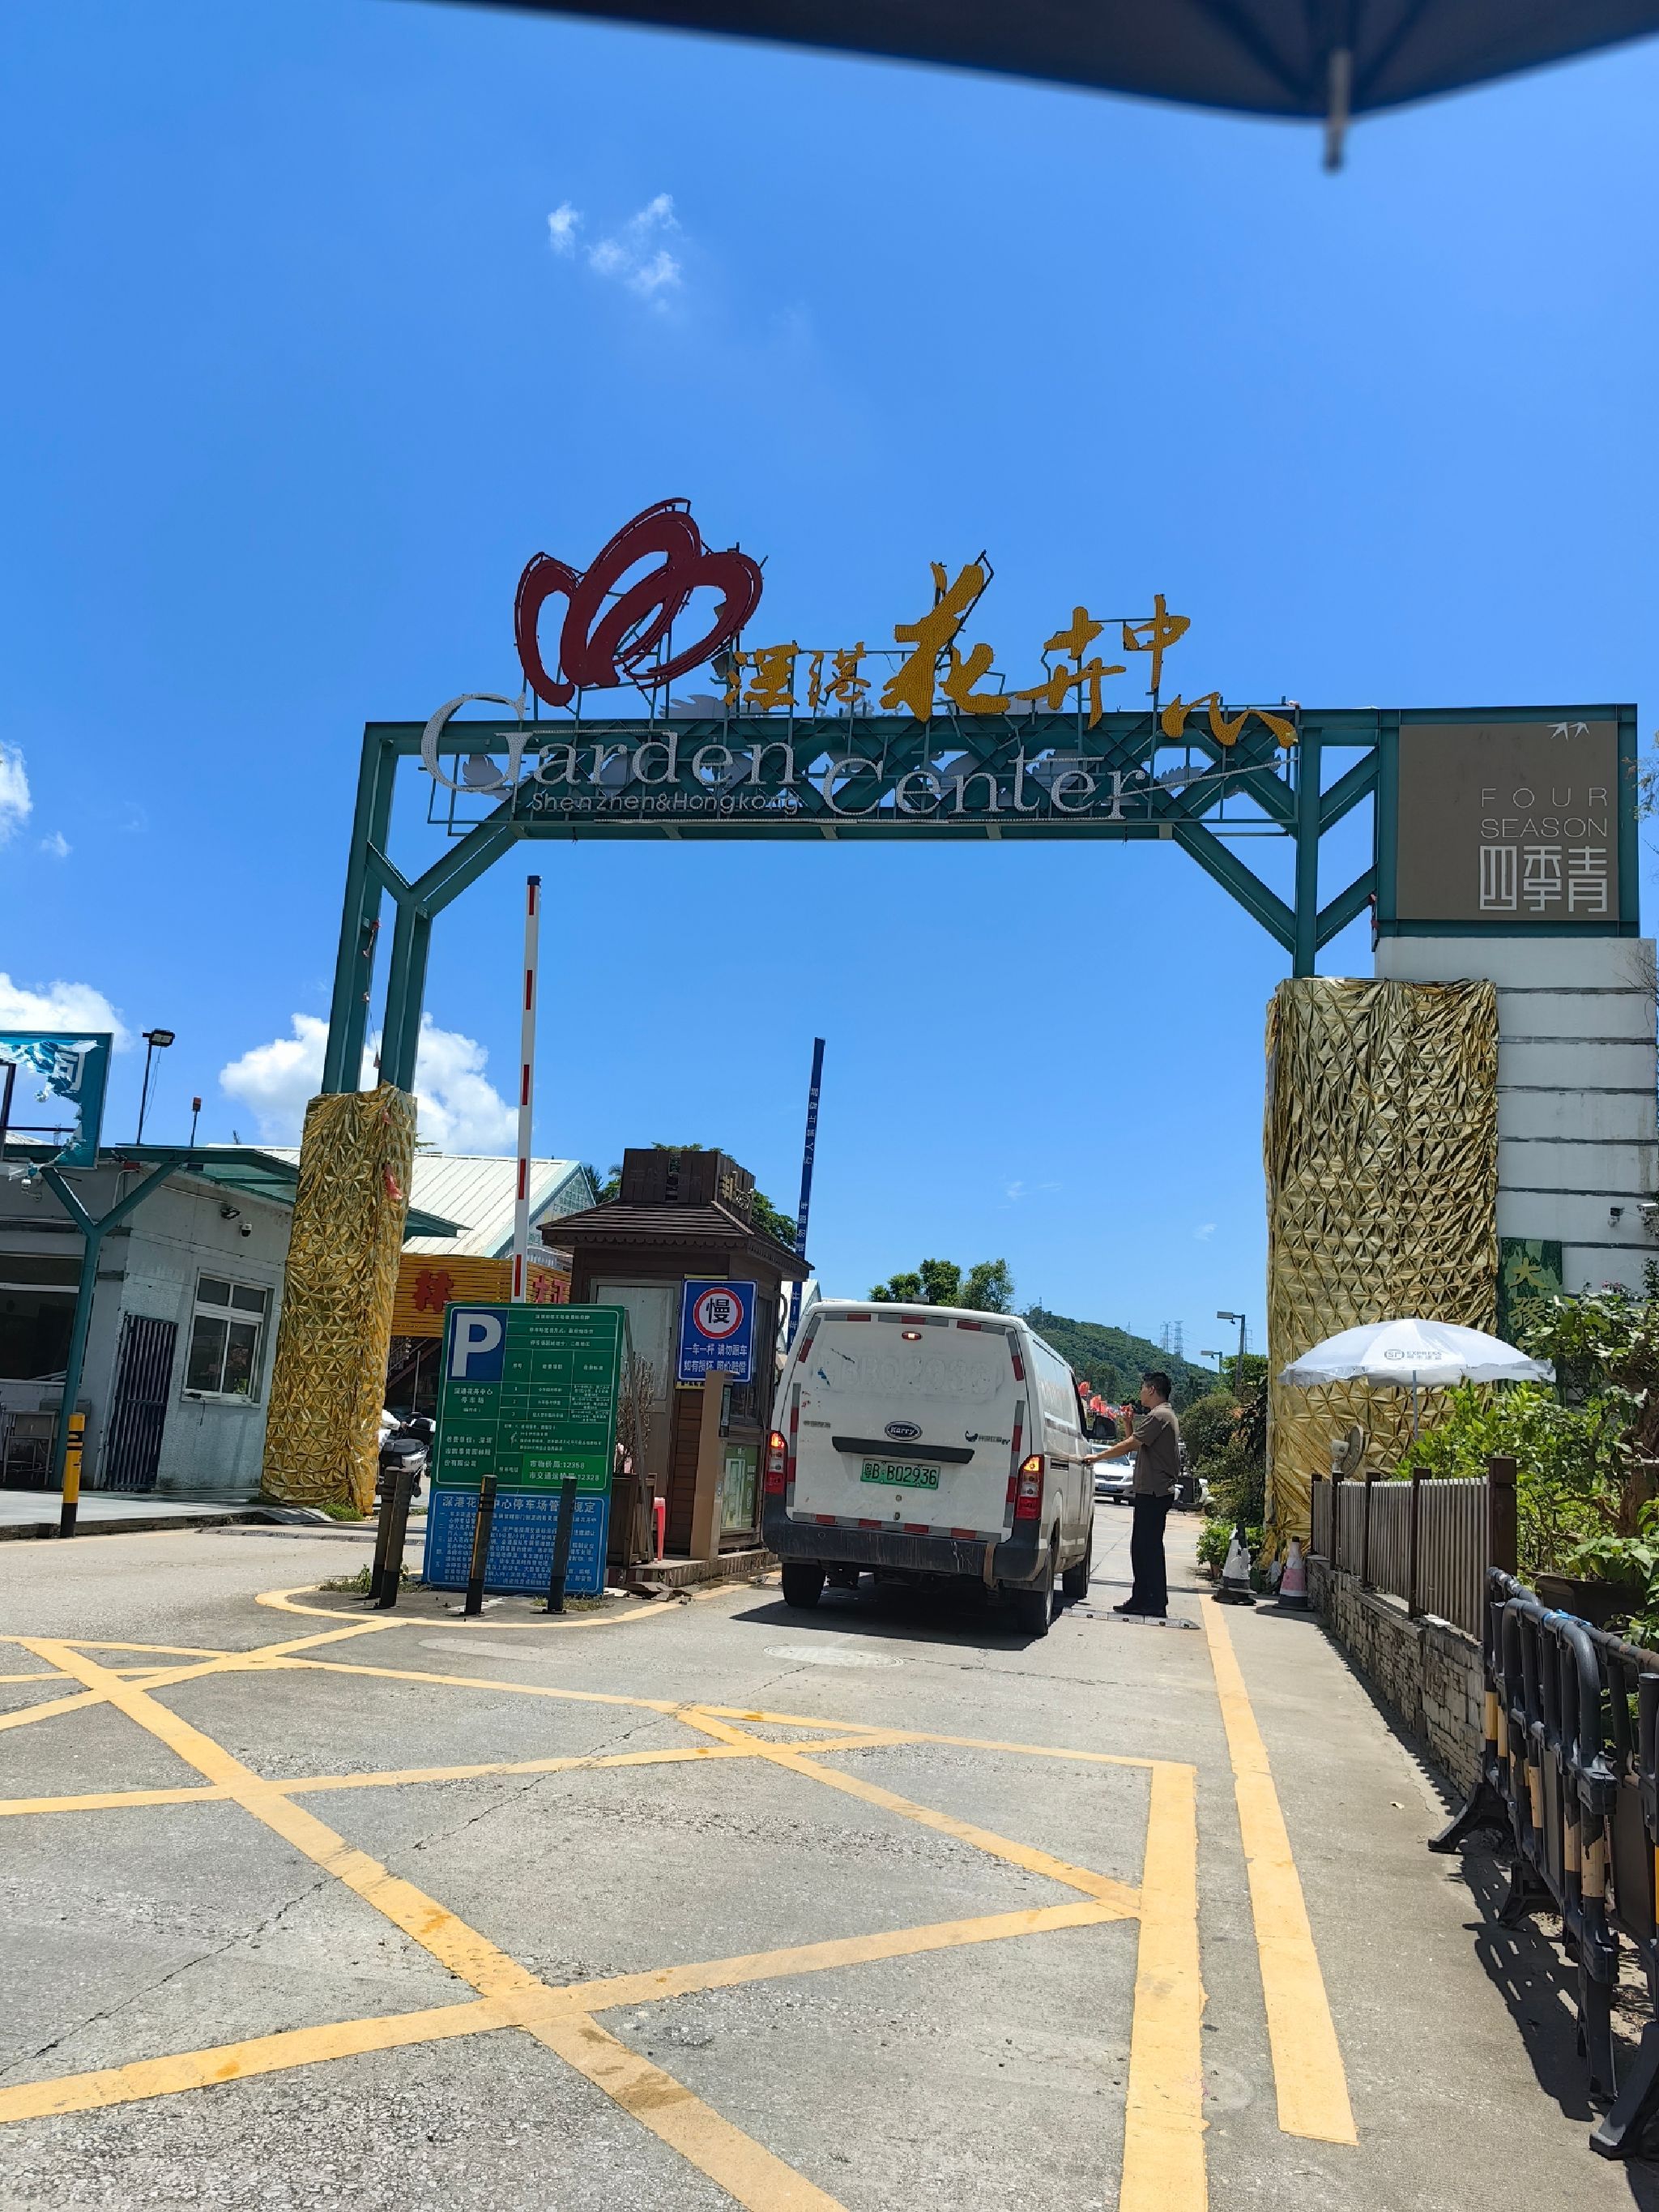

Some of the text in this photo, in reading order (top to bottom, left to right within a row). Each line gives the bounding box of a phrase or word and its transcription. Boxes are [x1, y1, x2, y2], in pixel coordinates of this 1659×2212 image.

[420, 693, 1147, 820] Garden Center
[531, 792, 800, 815] Shenzhen&Hongkong
[1481, 787, 1608, 809] FOUR
[1480, 817, 1608, 839] SEASON
[1479, 844, 1608, 912] 四季青
[706, 1296, 731, 1324] 慢
[451, 1313, 502, 1378] P
[684, 1343, 748, 1357] 一车一杆 请勿跟车
